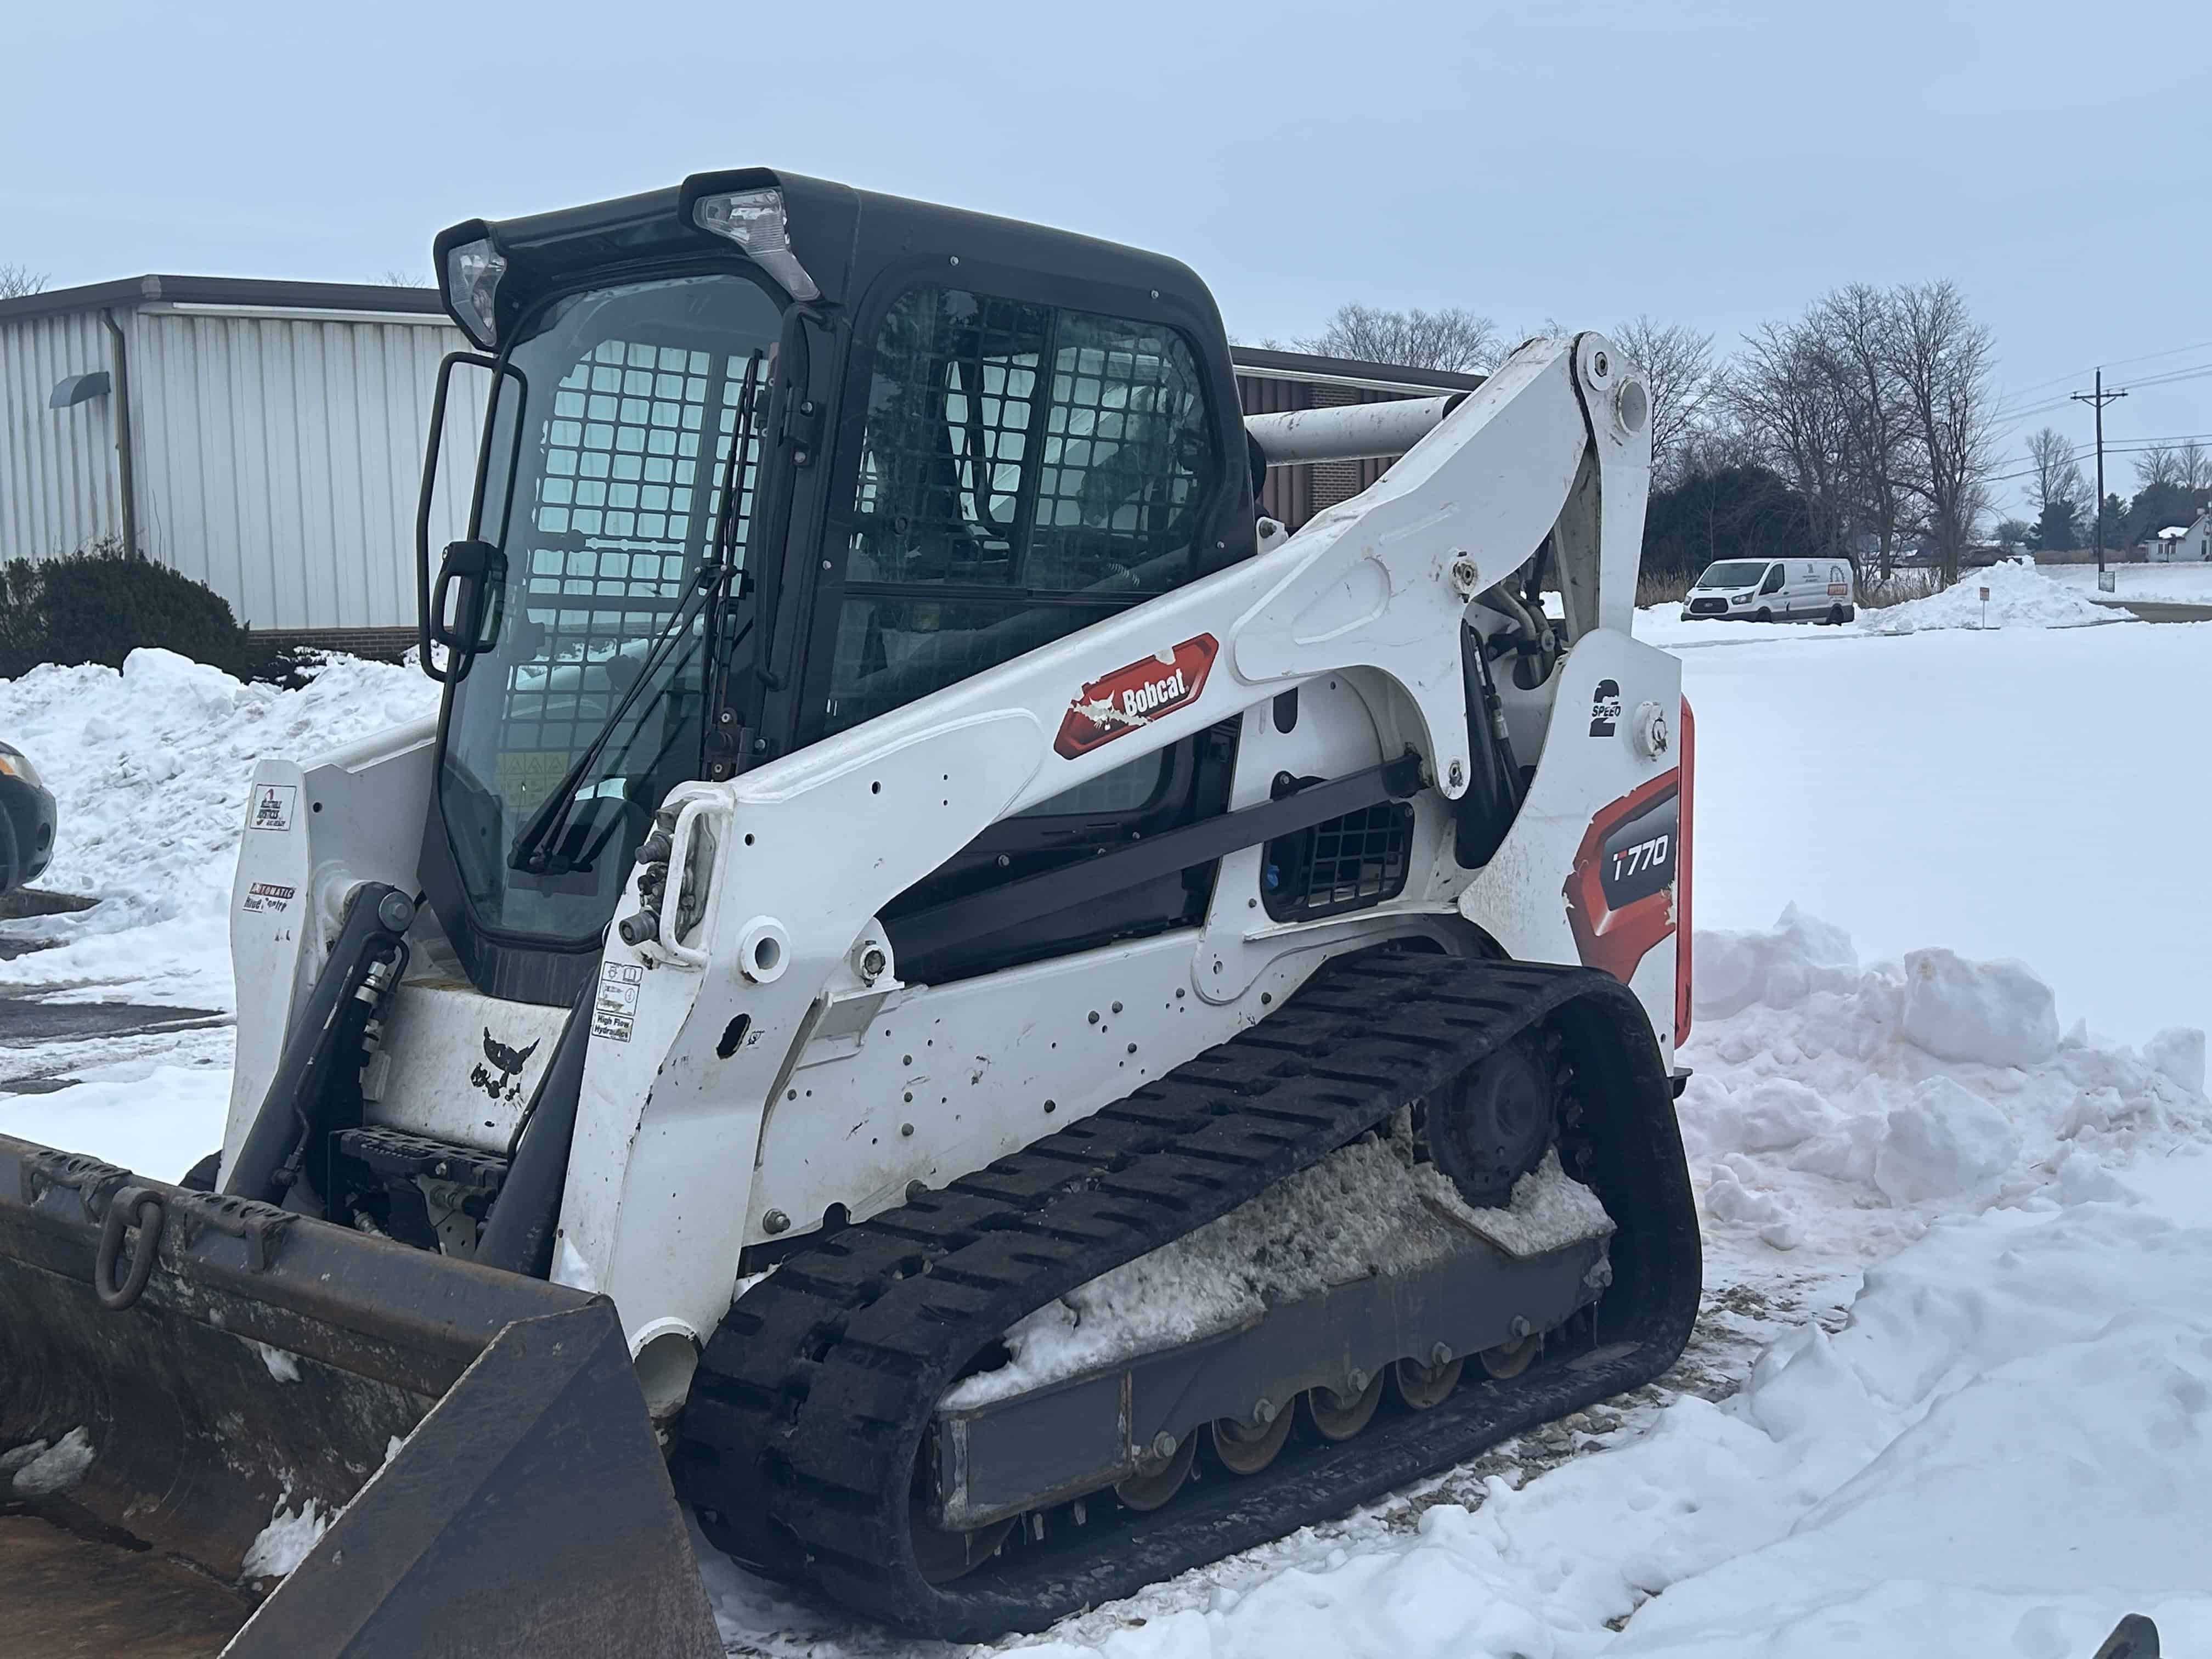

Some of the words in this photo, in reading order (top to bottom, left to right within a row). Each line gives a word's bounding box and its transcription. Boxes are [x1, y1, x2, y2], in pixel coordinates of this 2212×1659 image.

[1122, 668, 1186, 717] Bobcat
[1592, 705, 1621, 717] SPEED
[1612, 834, 1668, 881] T770
[251, 884, 293, 899] AUTOMATIC
[597, 1014, 613, 1025] High
[614, 1018, 630, 1028] Flow
[594, 1025, 628, 1039] Hydraulics
